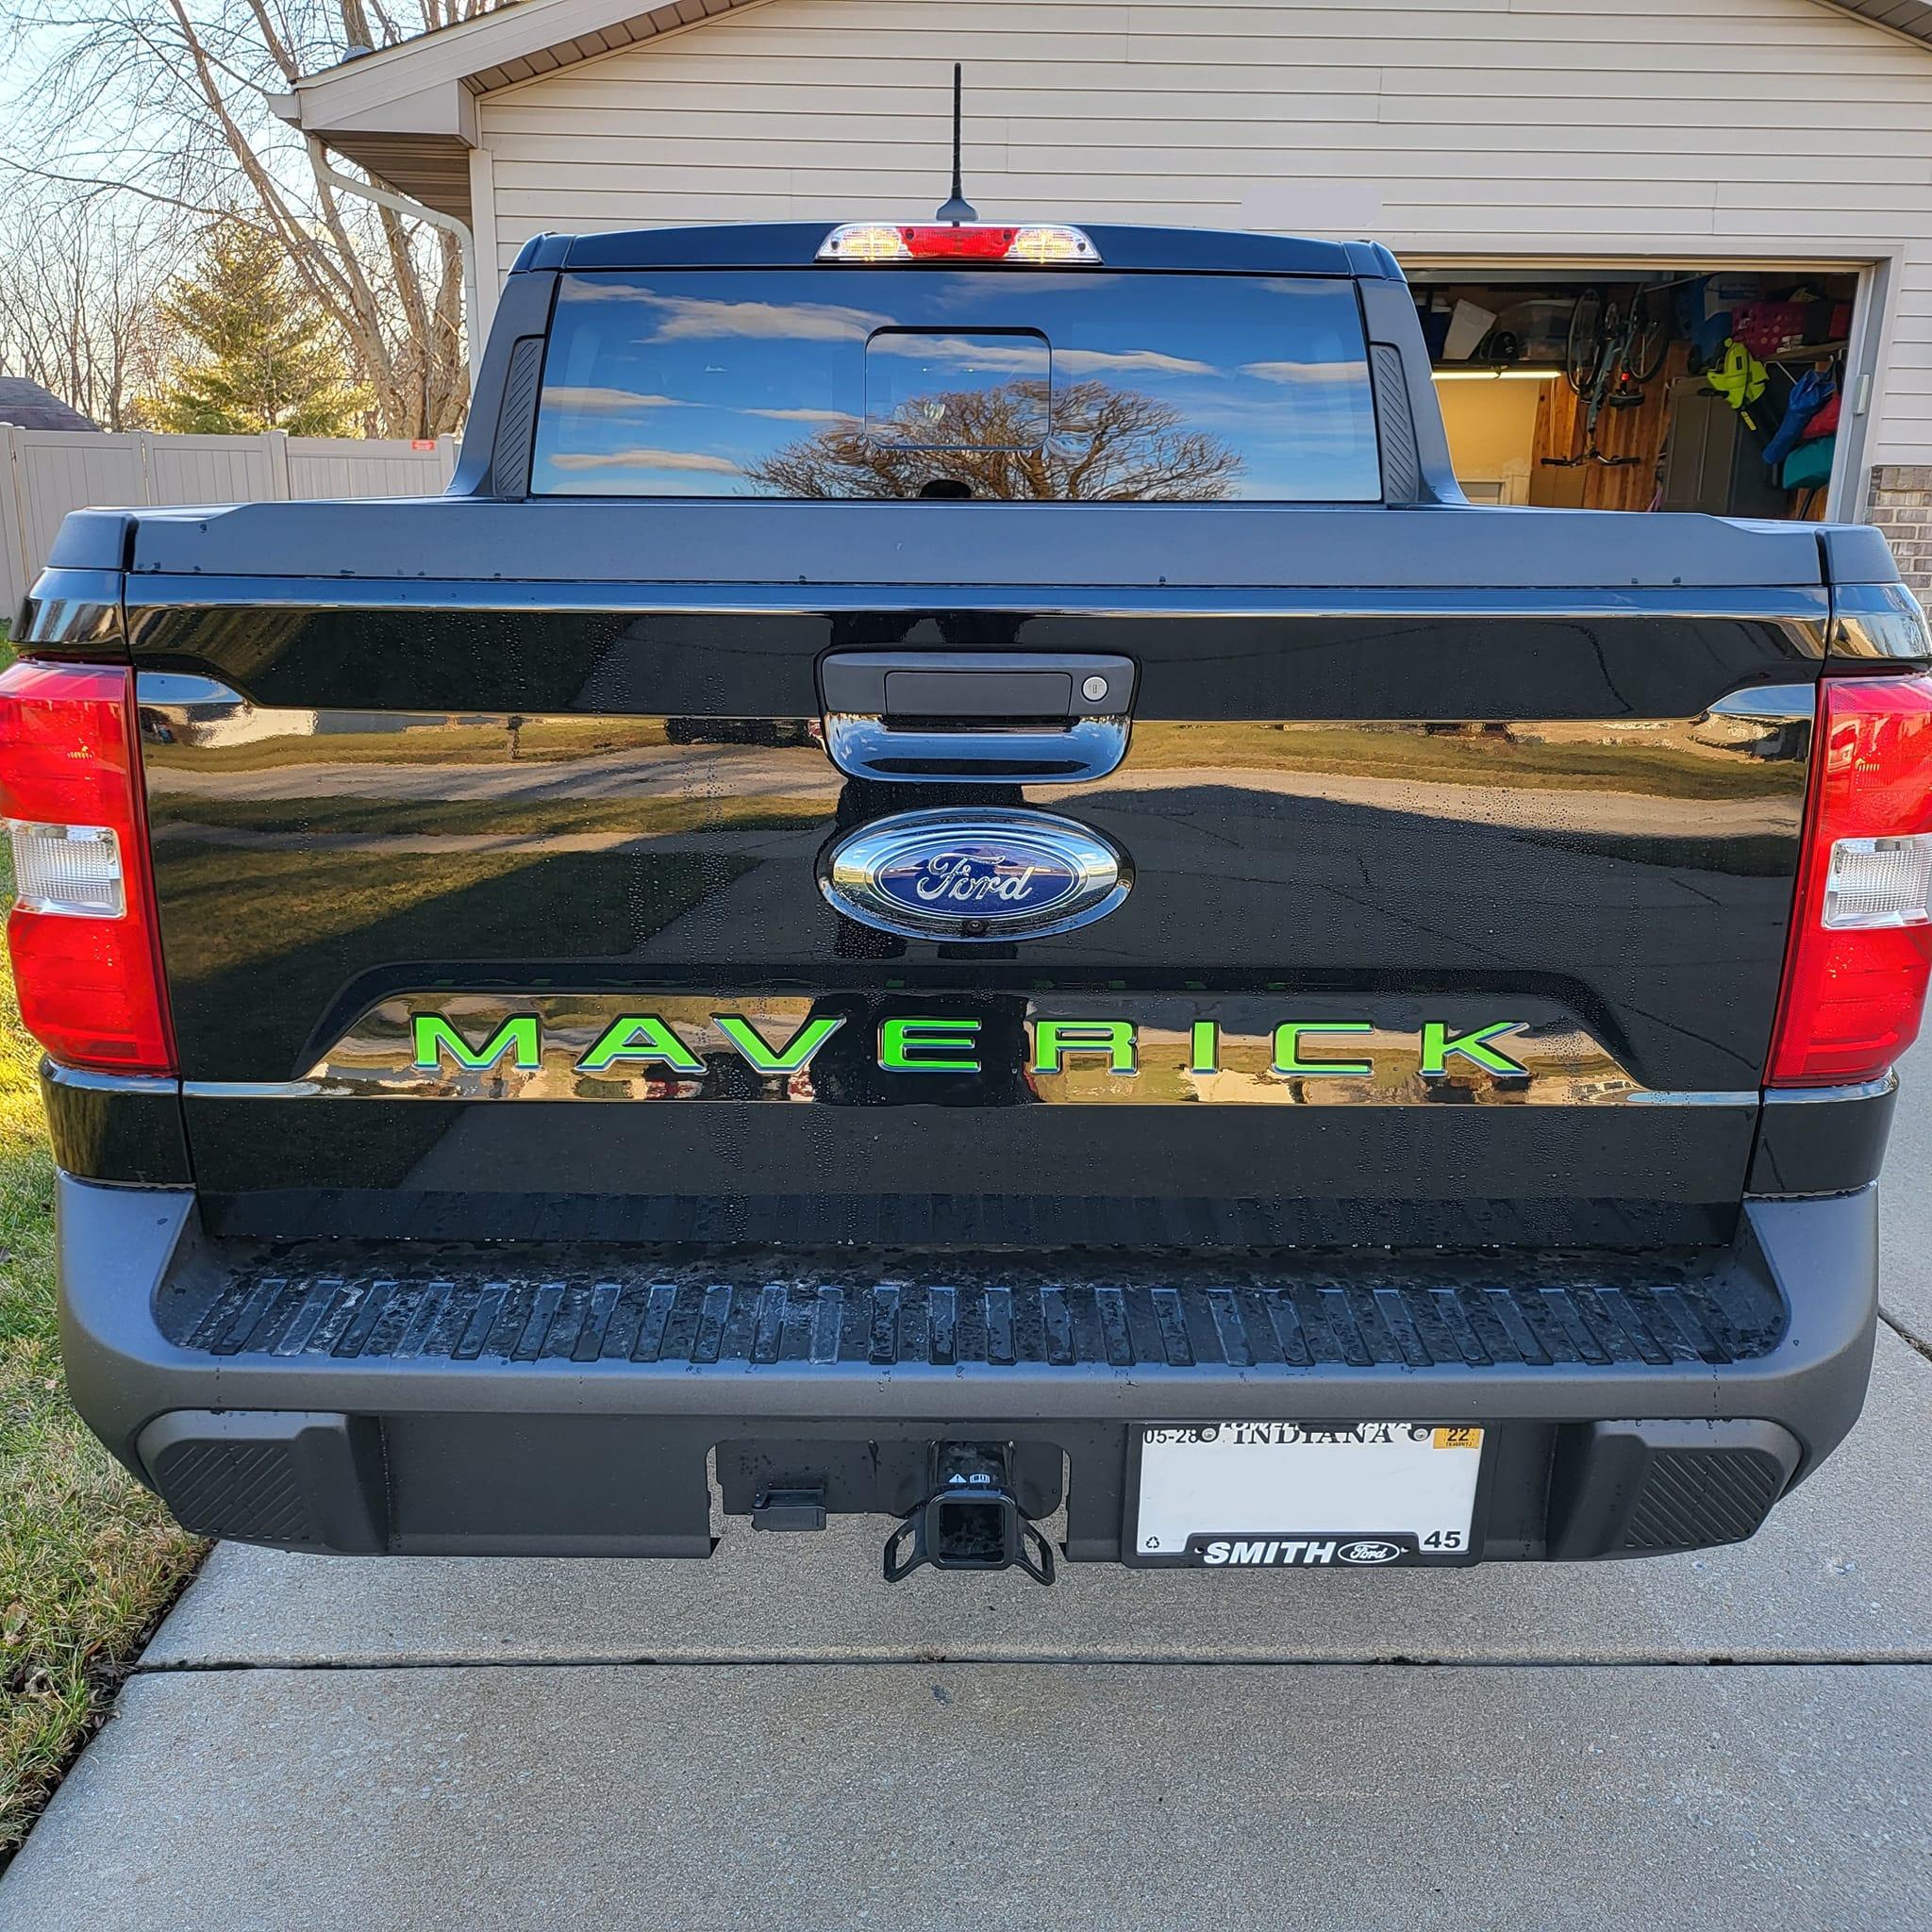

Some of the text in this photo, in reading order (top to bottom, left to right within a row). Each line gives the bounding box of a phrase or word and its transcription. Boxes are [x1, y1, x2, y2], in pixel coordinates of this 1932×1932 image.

[916, 852, 1035, 901] Ford
[410, 1012, 1530, 1080] MAVERICK
[1447, 1427, 1470, 1441] 22
[1423, 1530, 1461, 1549] 45
[1203, 1541, 1386, 1564] SMITH Ford
